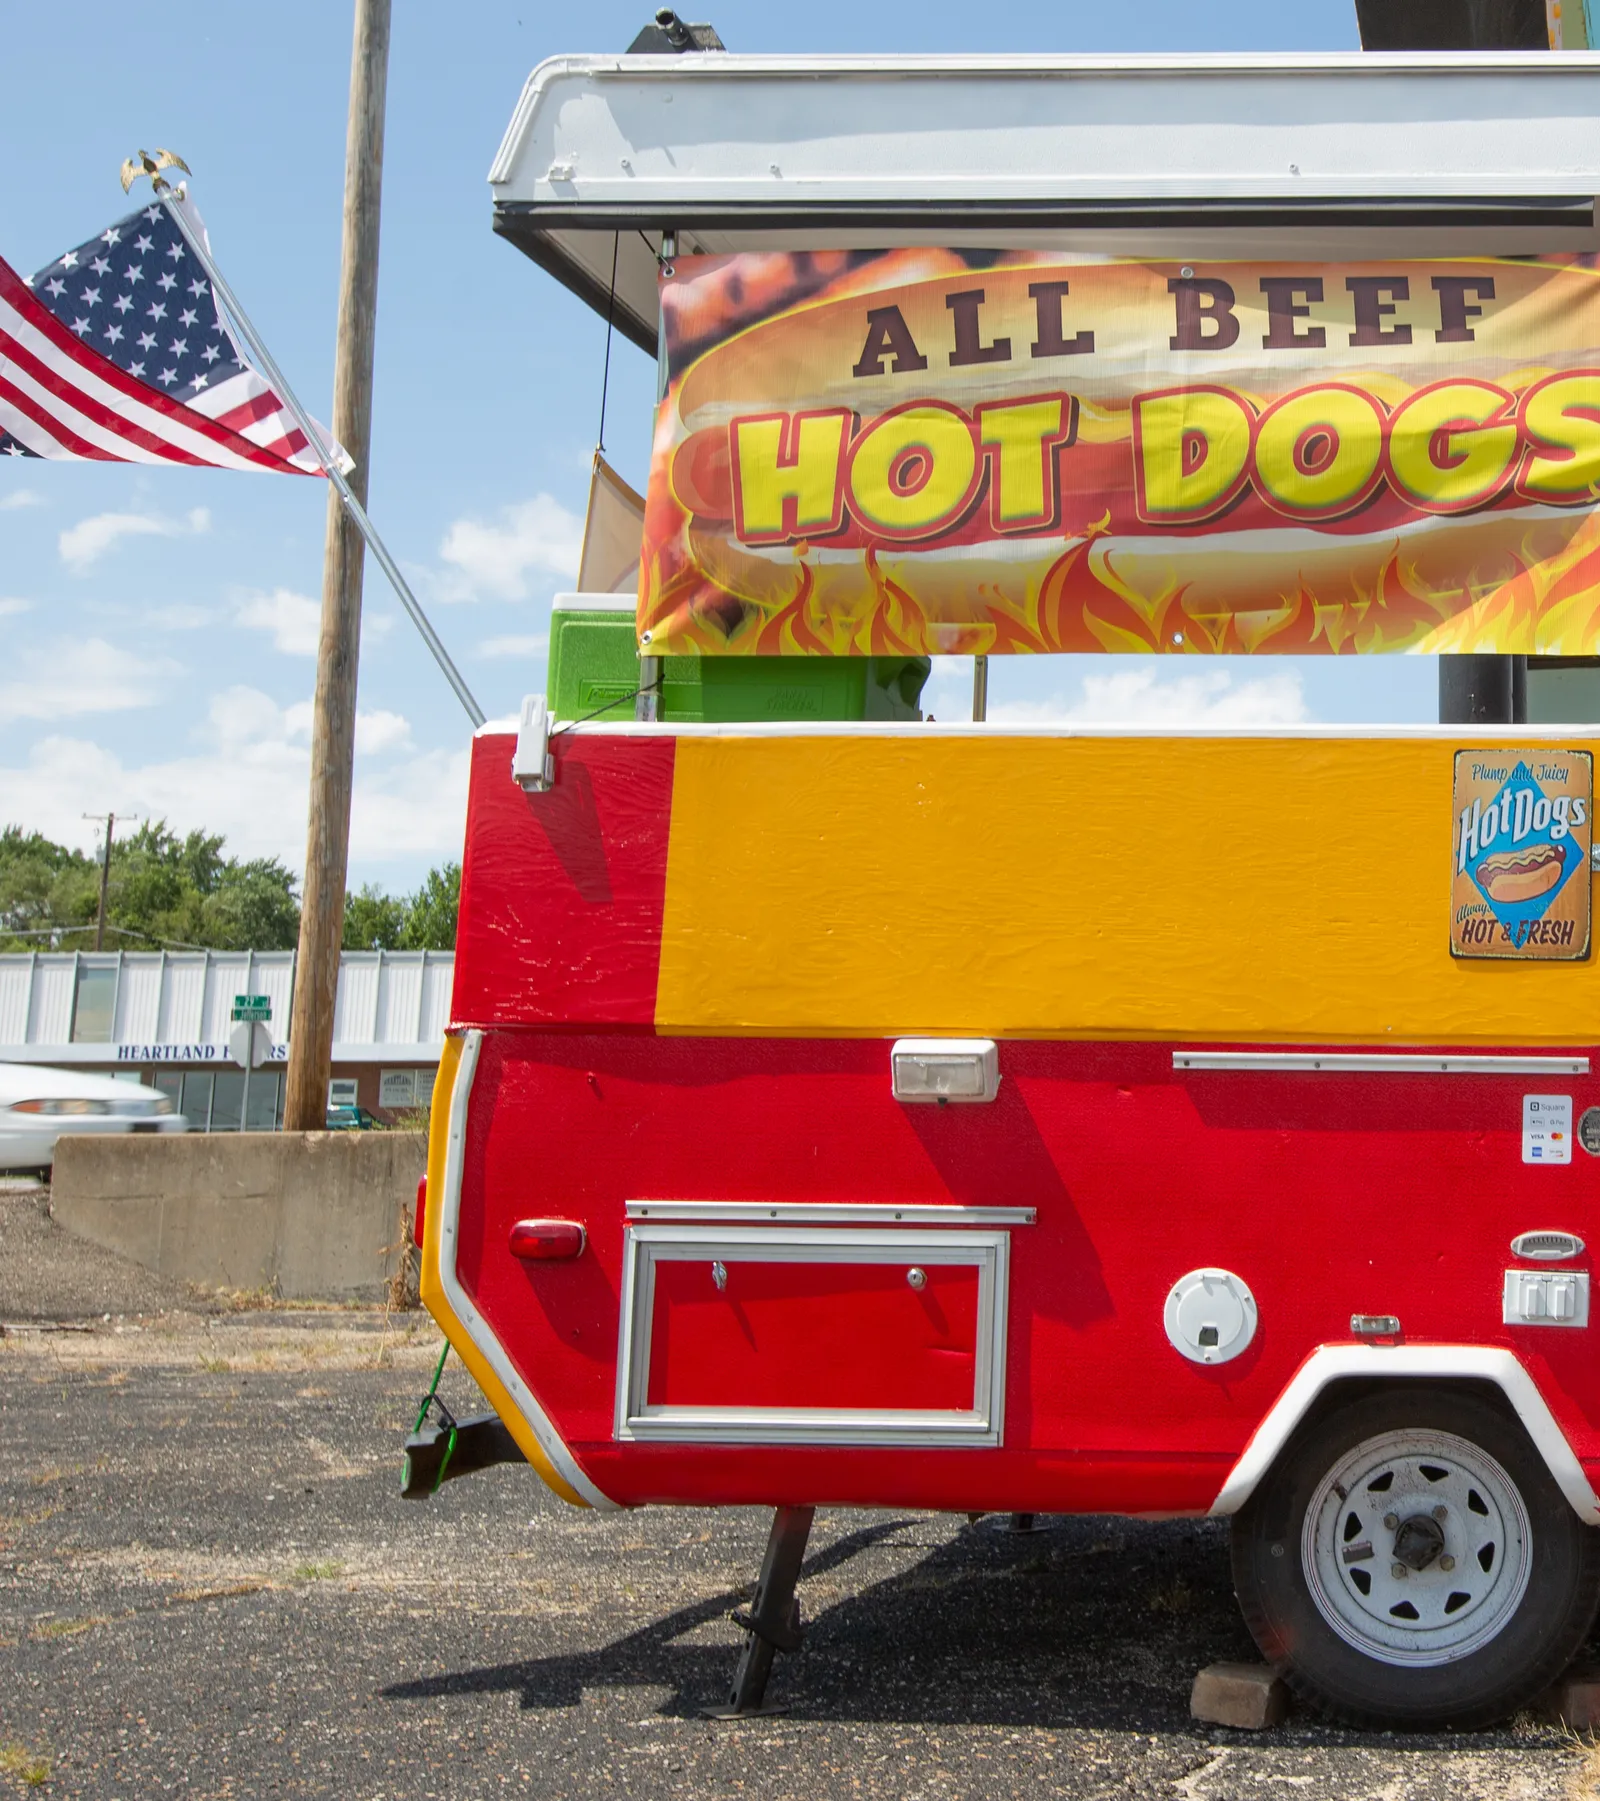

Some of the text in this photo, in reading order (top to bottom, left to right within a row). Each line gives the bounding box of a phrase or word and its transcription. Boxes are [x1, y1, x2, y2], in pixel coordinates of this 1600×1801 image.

[852, 276, 1496, 377] ALL BEEF
[729, 391, 1080, 546] HOT
[1472, 763, 1569, 784] Plump and Juicy
[1457, 787, 1587, 877] Hot Dogs
[1456, 902, 1493, 924] Always
[1461, 919, 1575, 946] HOT & FRESH
[117, 1045, 215, 1059] HEARTLAND
[1541, 1103, 1566, 1112] Square
